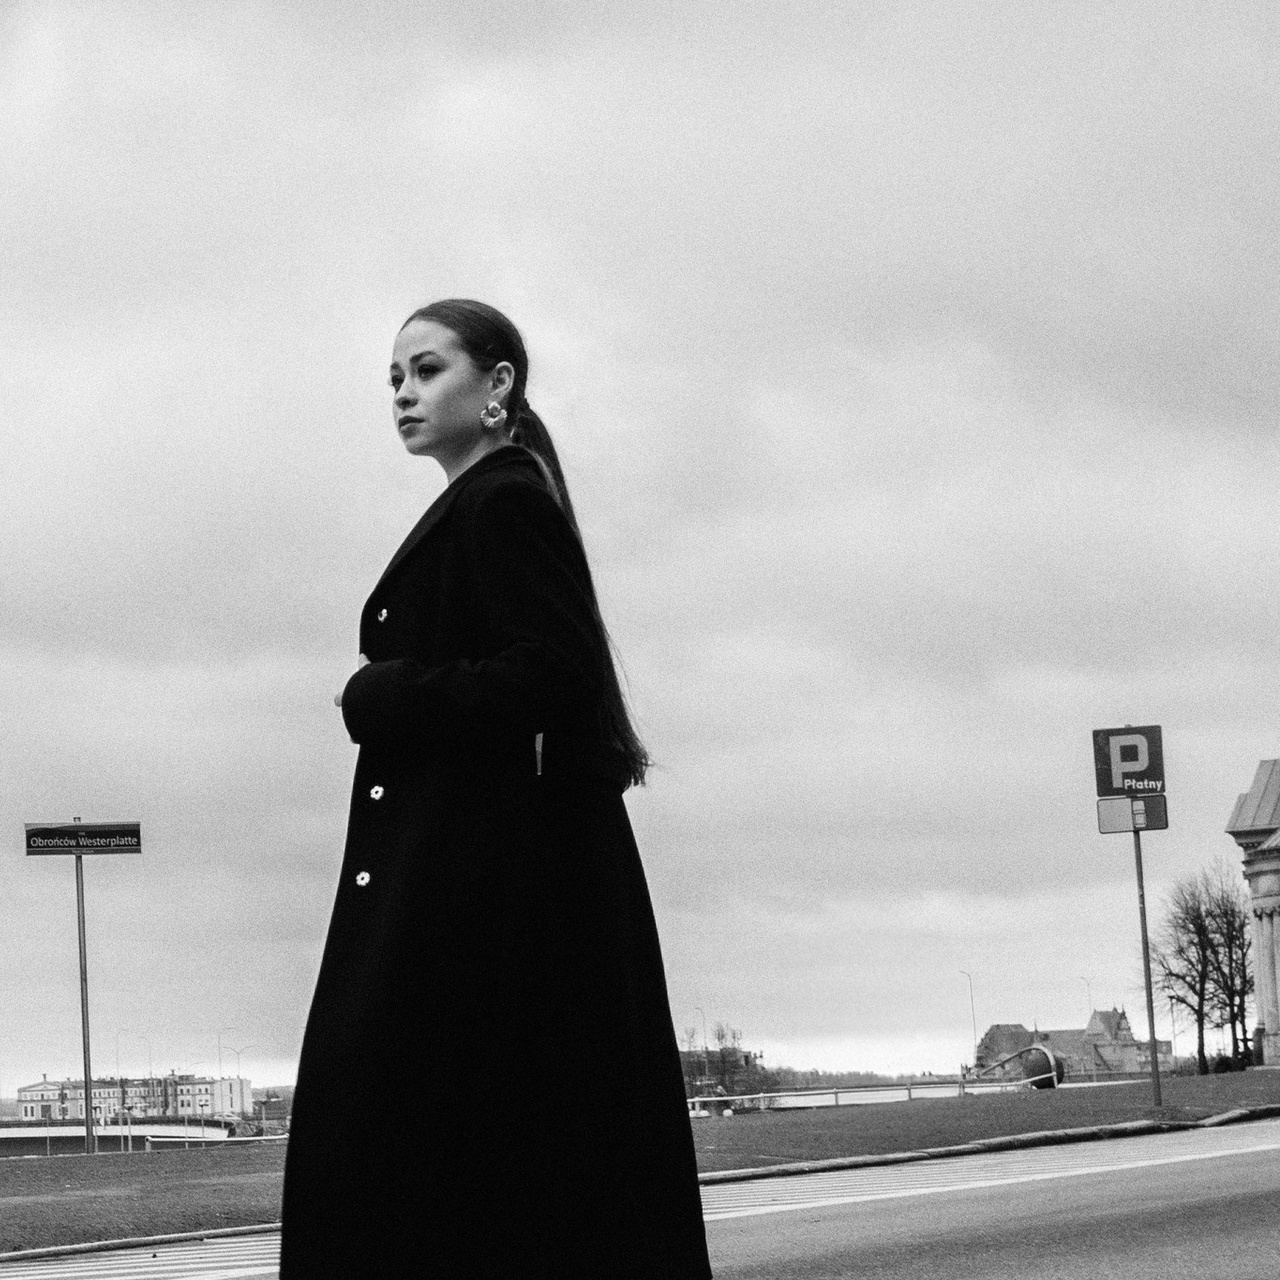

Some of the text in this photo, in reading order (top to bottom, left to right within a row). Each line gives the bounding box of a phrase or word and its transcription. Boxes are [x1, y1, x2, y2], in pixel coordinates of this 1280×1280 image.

[1109, 734, 1149, 788] P
[1124, 779, 1163, 791] Płatny
[30, 835, 138, 847] Obrońców Westerplatte
